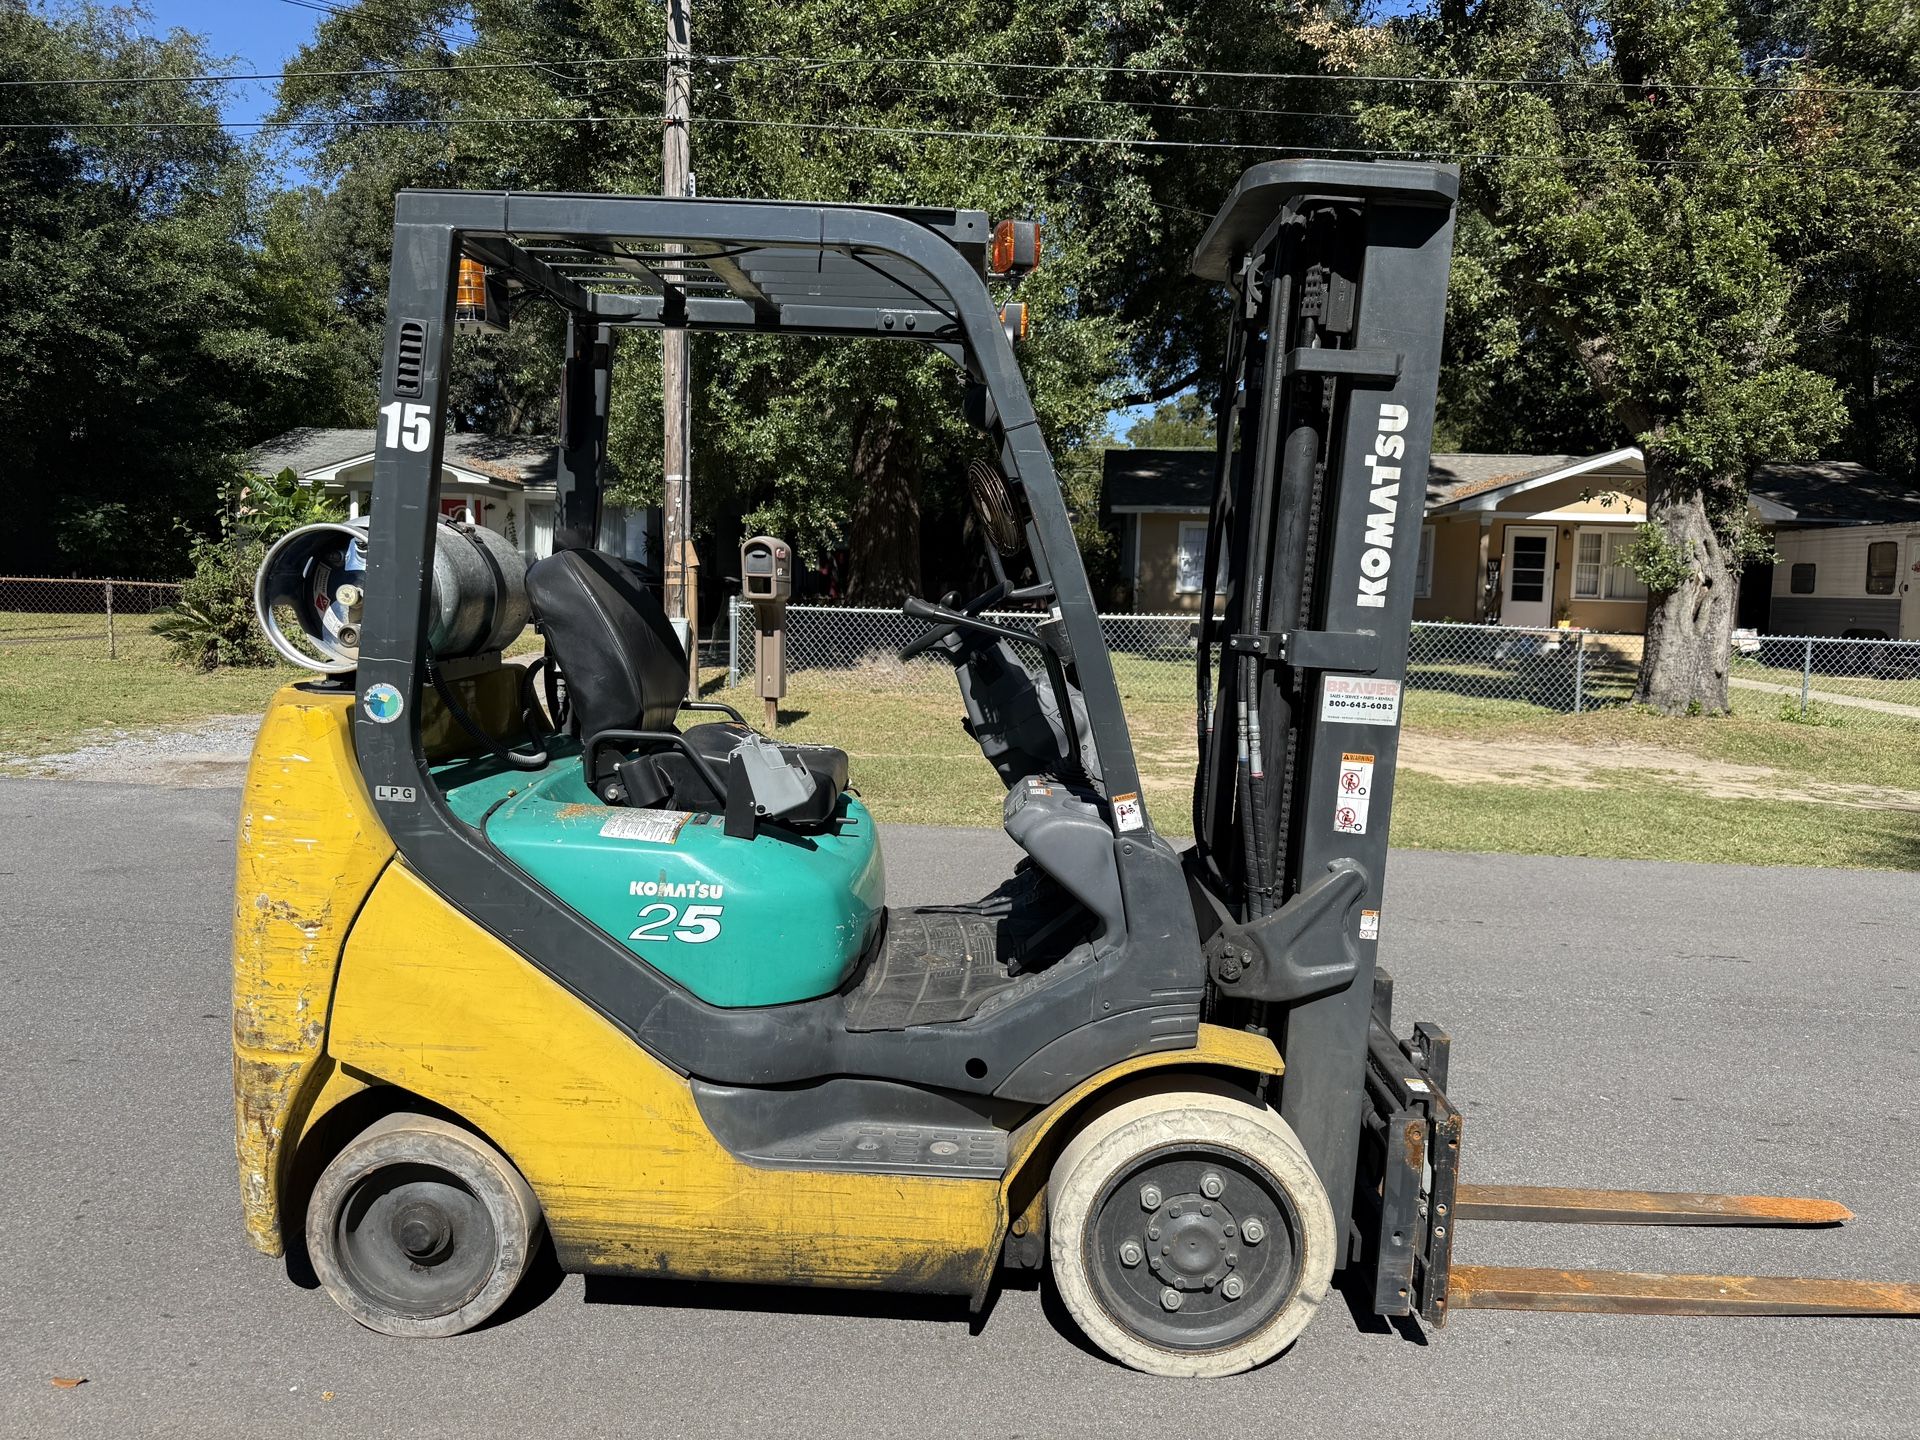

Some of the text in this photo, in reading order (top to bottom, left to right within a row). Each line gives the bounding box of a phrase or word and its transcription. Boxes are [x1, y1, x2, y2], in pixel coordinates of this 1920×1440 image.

[381, 401, 431, 453] 15
[1356, 403, 1409, 608] KOMATSU
[1326, 680, 1398, 696] BRAUER
[1329, 700, 1393, 710] 800-645-6083
[1350, 754, 1374, 763] WARNING
[629, 880, 724, 899] KOMATSU
[628, 902, 724, 944] 25
